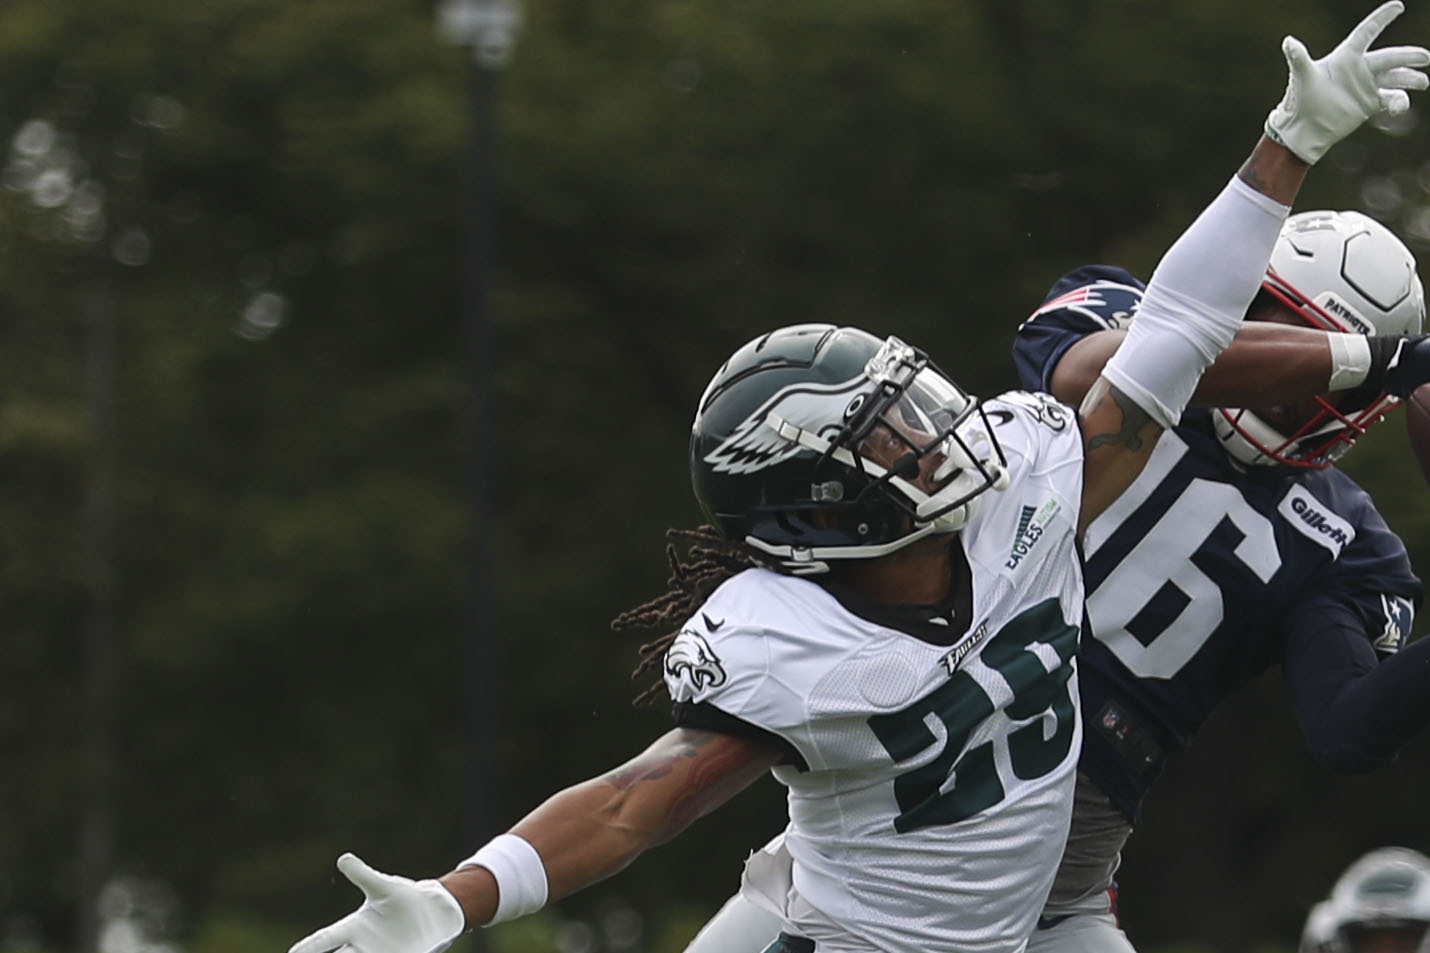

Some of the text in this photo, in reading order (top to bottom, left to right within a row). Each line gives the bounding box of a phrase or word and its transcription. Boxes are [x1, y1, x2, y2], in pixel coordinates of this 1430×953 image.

[1290, 496, 1348, 546] Gillett
[1005, 523, 1043, 571] EAGLES
[867, 597, 1081, 834] 29
